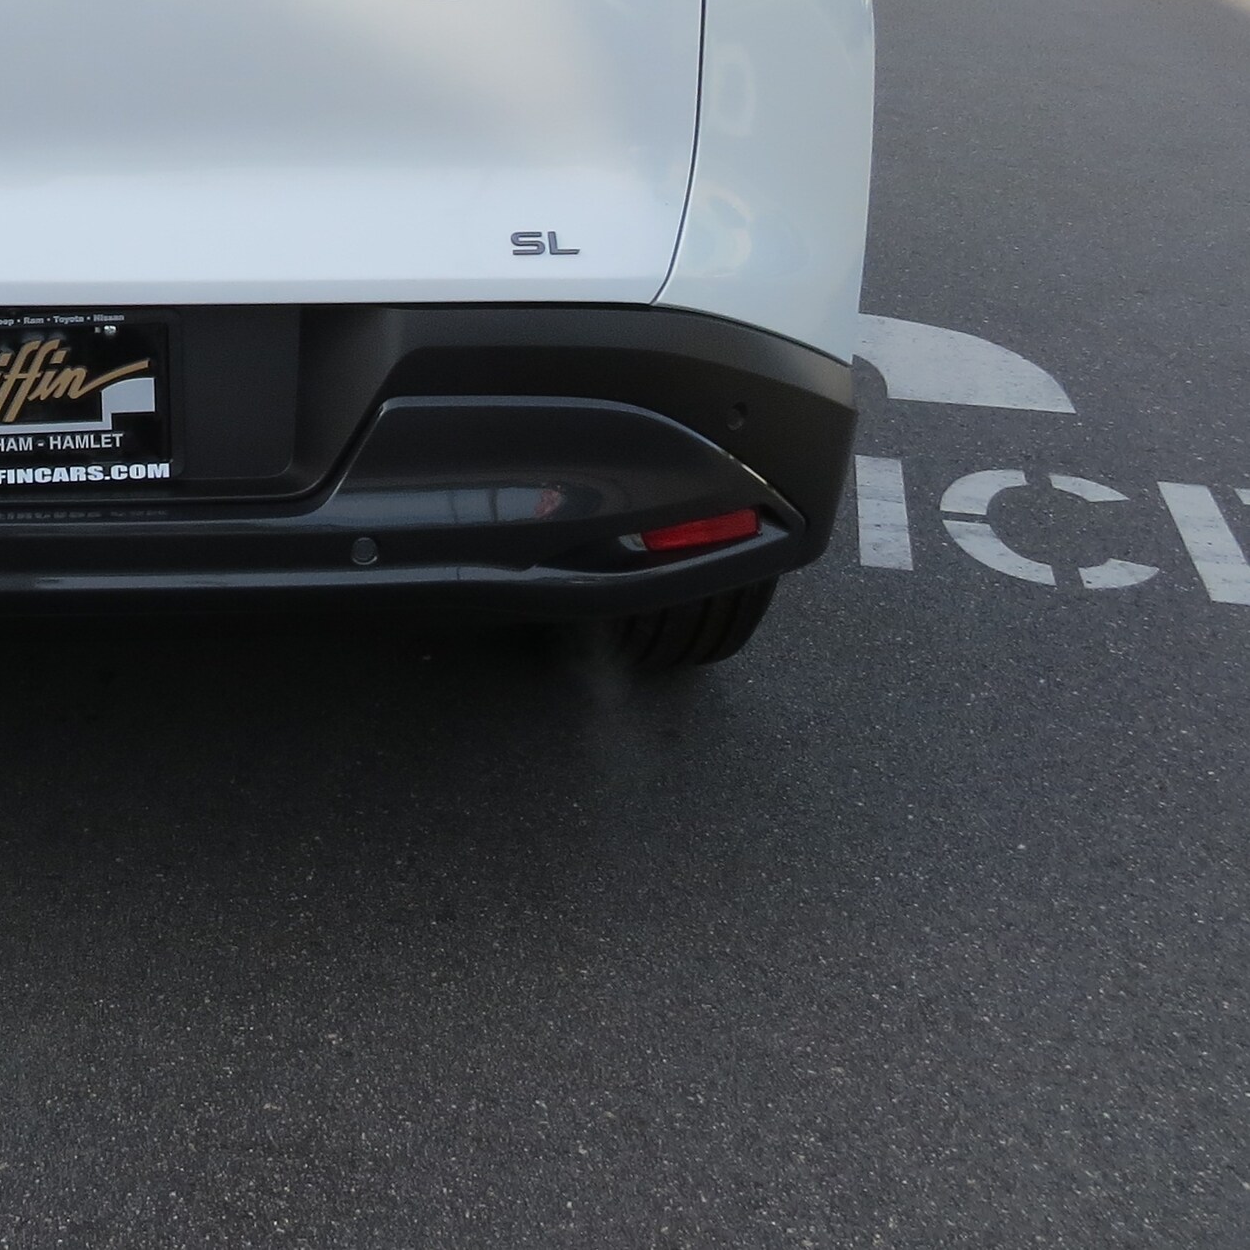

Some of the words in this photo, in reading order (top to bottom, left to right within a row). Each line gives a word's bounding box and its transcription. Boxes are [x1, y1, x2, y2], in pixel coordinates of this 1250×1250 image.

[510, 231, 580, 255] SL
[23, 316, 44, 325] Ram
[53, 315, 85, 325] Toyota
[49, 434, 124, 450] HAMLET
